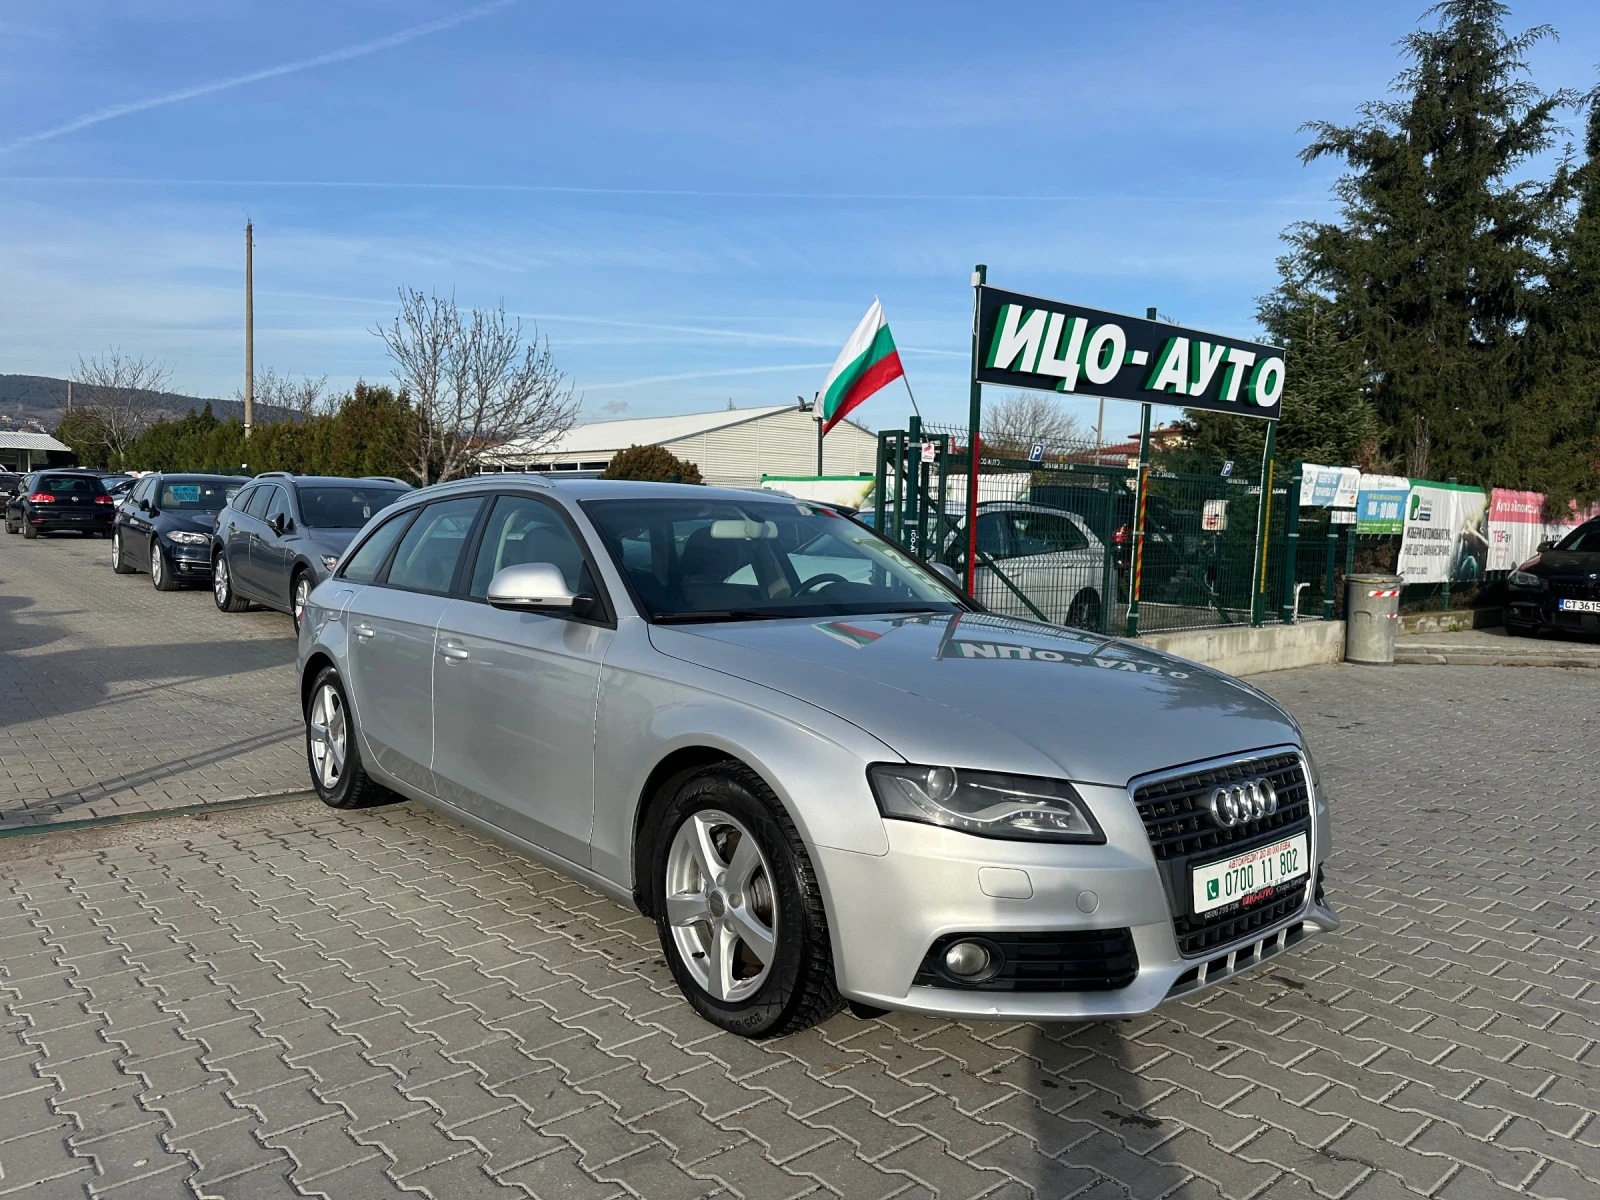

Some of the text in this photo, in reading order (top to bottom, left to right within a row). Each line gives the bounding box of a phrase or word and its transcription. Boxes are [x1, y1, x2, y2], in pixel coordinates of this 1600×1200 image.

[987, 303, 1285, 407] ИЦО-АУТО
[1032, 446, 1042, 459] P
[1224, 463, 1232, 475] P
[1225, 864, 1254, 897] 0700
[1261, 857, 1273, 882] 11
[1280, 848, 1299, 876] 802
